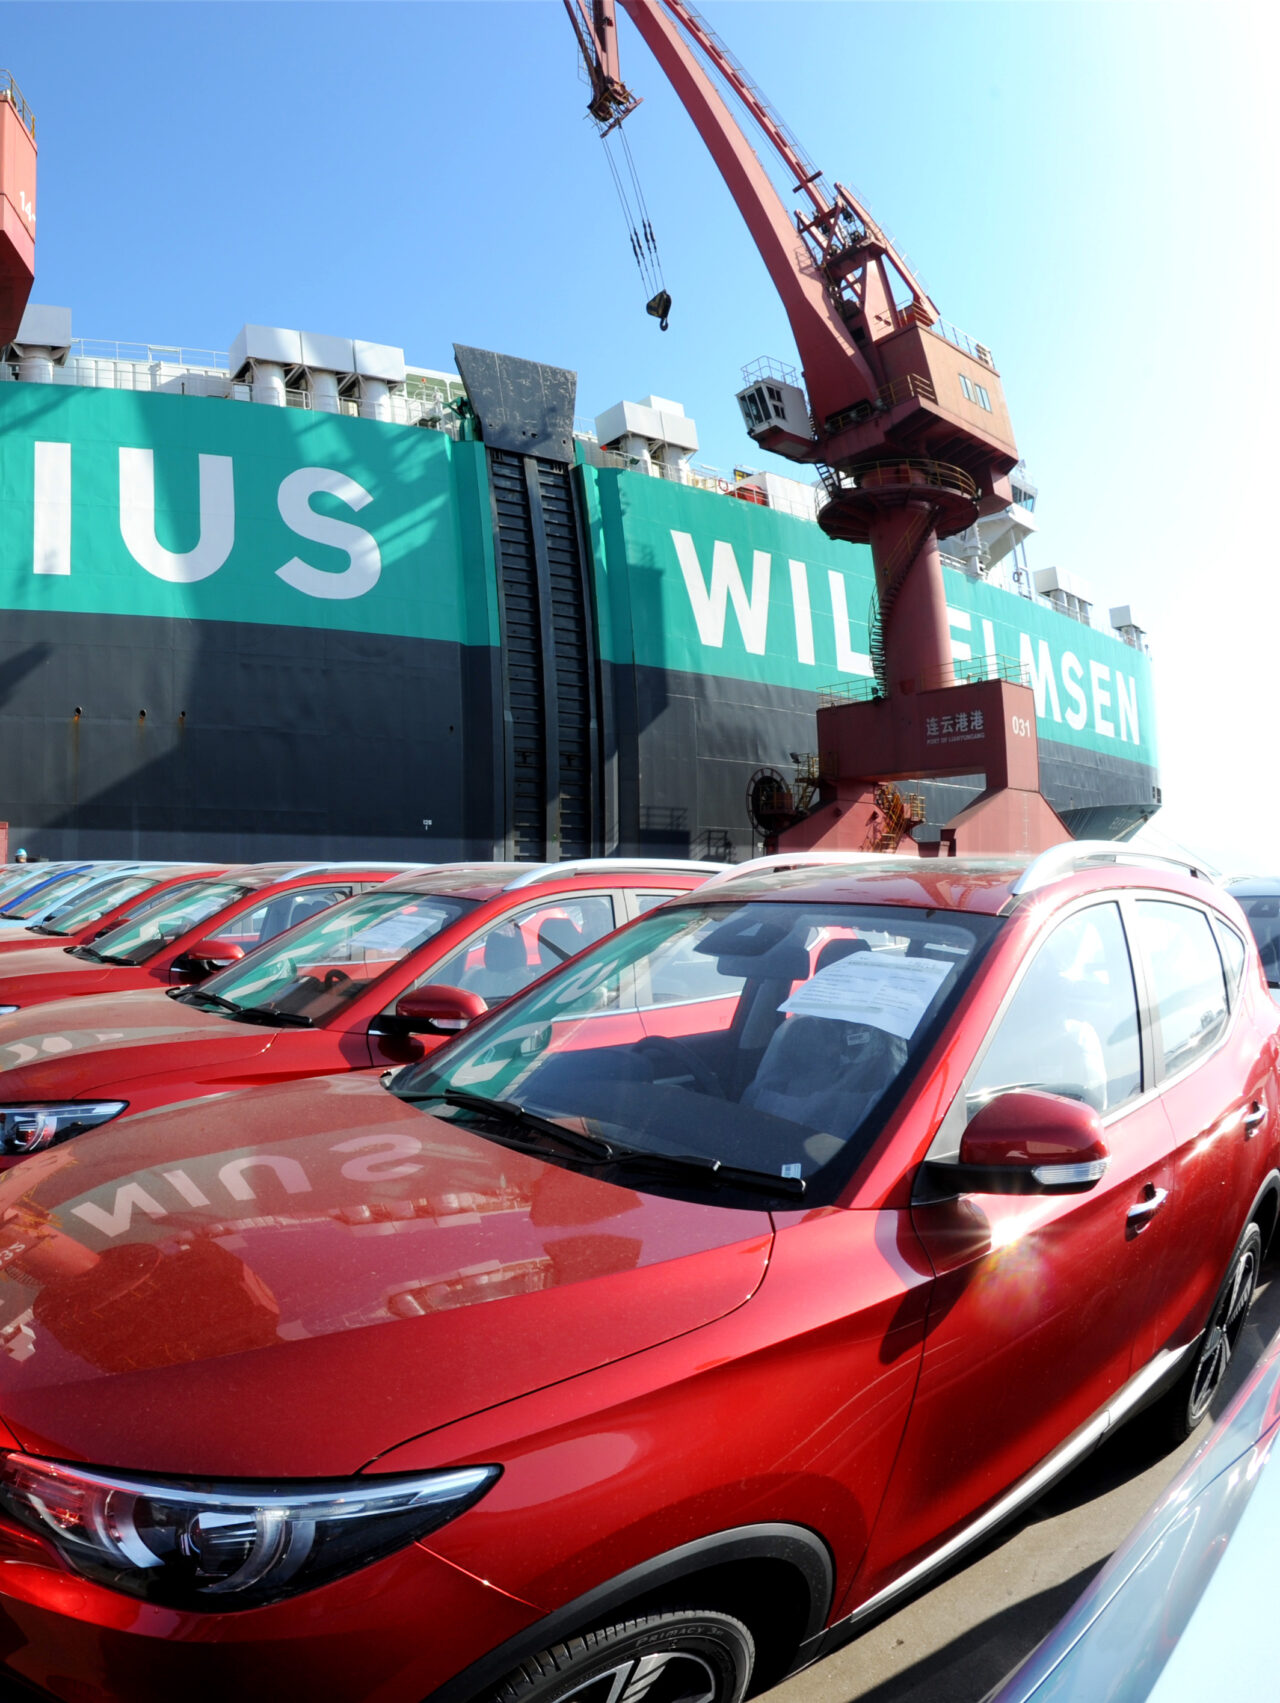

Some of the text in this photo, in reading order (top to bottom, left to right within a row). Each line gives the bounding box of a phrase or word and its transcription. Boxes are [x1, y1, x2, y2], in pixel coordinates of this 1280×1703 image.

[20, 191, 36, 222] 14
[670, 529, 1140, 746] WILEMSEN
[926, 709, 984, 736] 连云港港
[1012, 715, 1031, 738] 031
